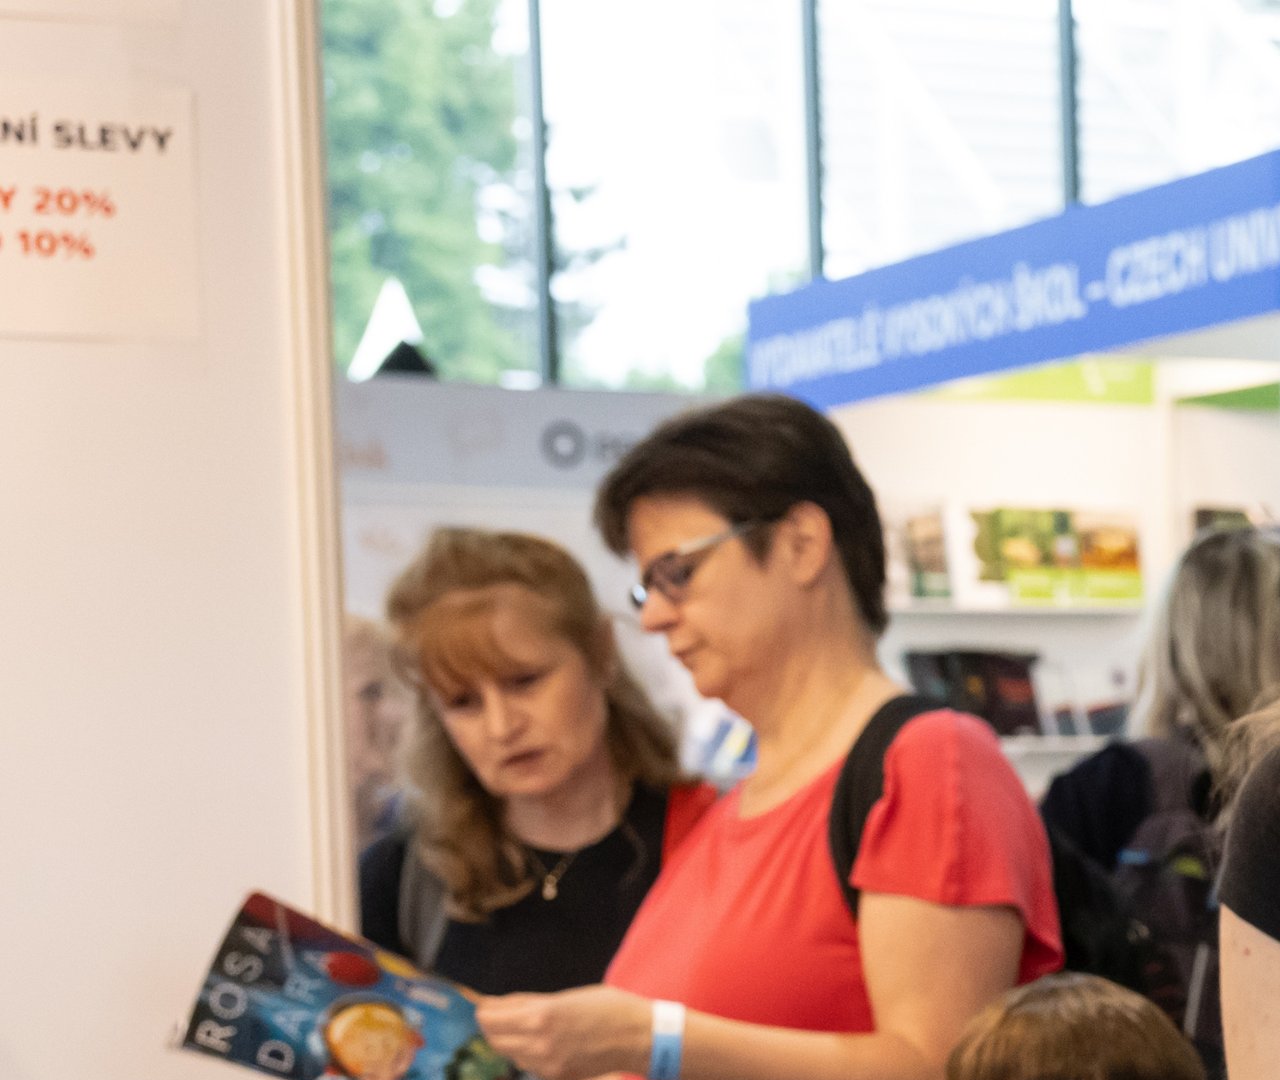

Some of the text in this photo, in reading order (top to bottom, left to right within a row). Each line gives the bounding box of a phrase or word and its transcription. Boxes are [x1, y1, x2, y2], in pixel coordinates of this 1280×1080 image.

[53, 119, 173, 154] SLEVY
[35, 187, 117, 218] 20%
[18, 229, 95, 260] 10%
[1107, 229, 1207, 307] CZECH
[194, 926, 275, 1054] ROSA
